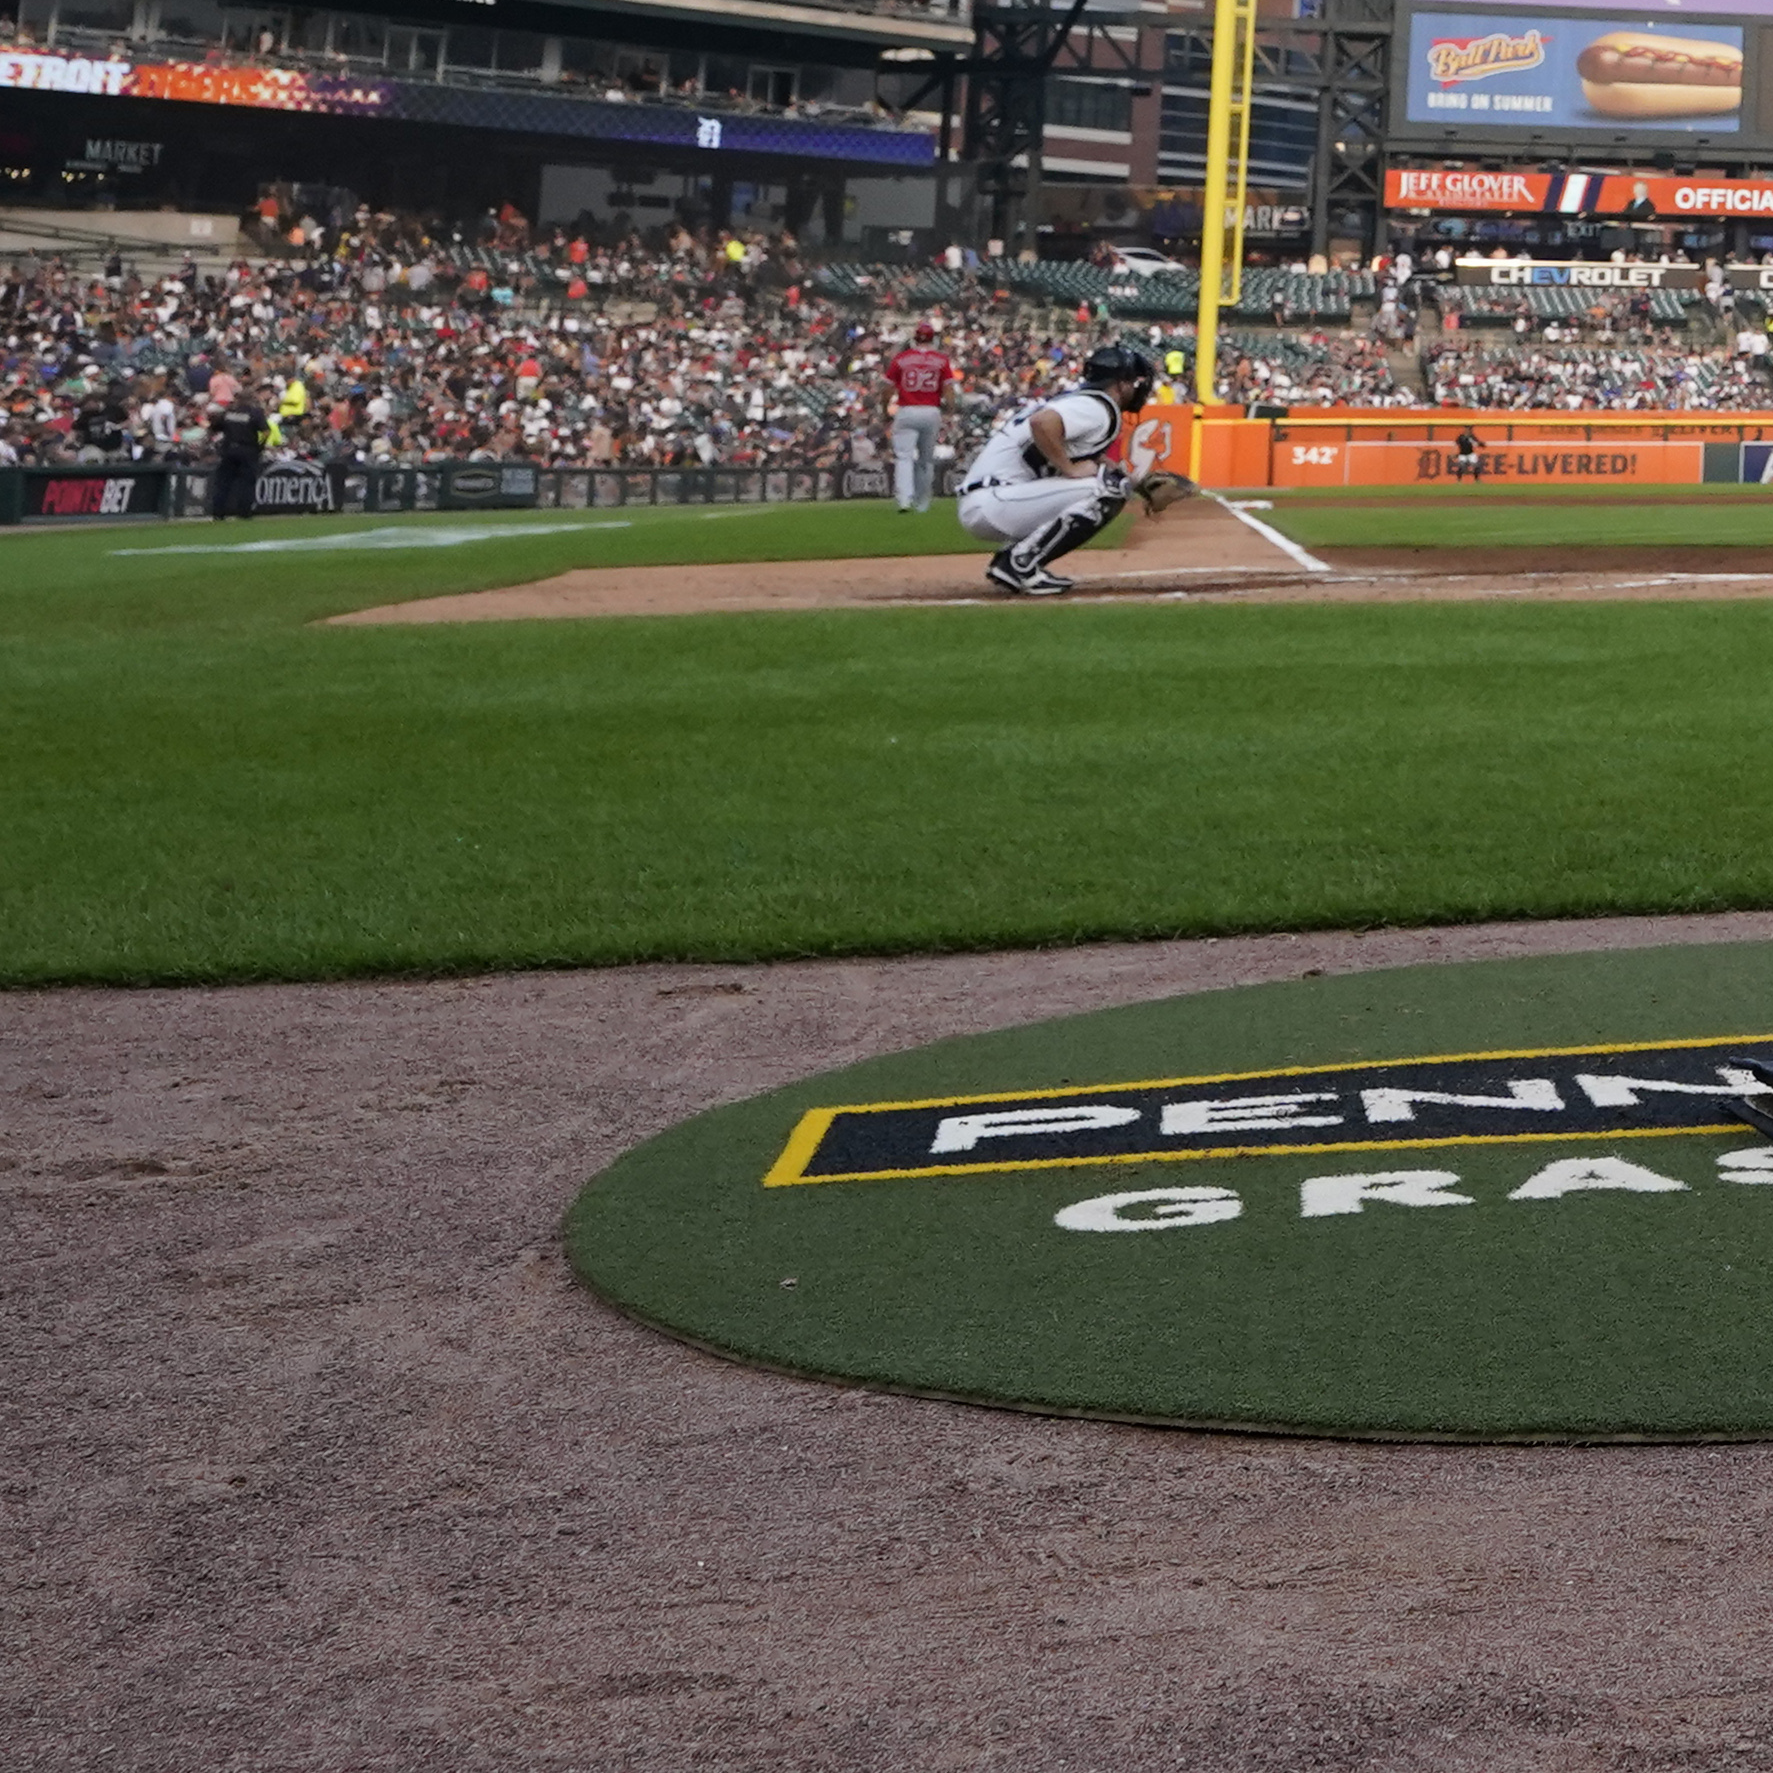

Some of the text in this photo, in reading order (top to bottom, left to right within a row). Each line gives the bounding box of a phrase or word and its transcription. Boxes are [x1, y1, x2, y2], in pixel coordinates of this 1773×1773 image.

[1470, 94, 1490, 109] ON
[1493, 95, 1552, 112] SUMMER
[84, 140, 163, 166] MARKET
[1399, 172, 1534, 203] JEFF GLOVER
[1490, 267, 1666, 286] CHEVROLET
[902, 367, 939, 393] 92
[42, 478, 135, 514] POINTSBET
